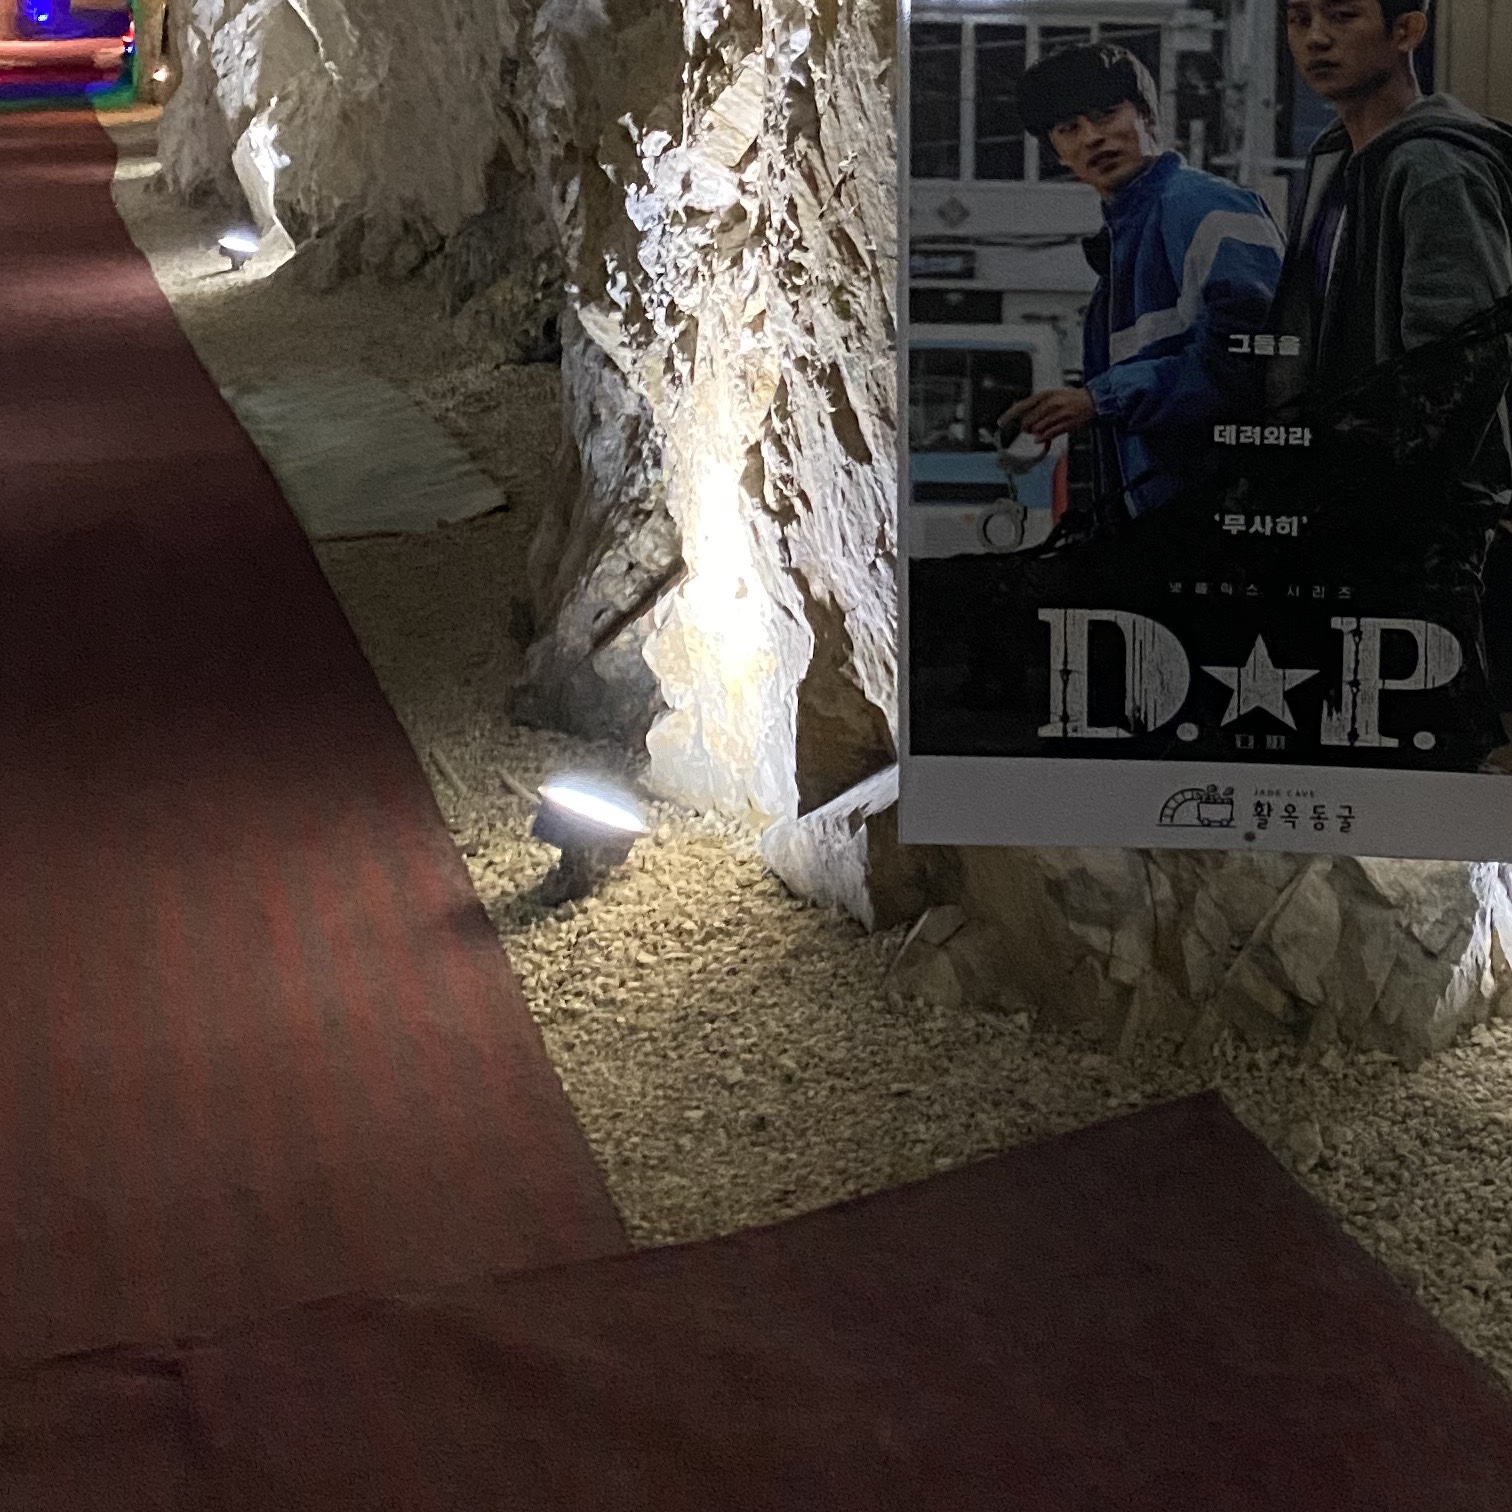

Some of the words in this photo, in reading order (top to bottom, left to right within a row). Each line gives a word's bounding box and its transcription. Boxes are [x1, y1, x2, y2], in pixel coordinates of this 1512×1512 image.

[1228, 334, 1300, 356] 그들을
[1213, 424, 1312, 447] 데려와라
[1213, 512, 1308, 536] '무사히'
[1287, 585, 1352, 599] 시리즈
[1252, 800, 1355, 833] 활옥동굴
